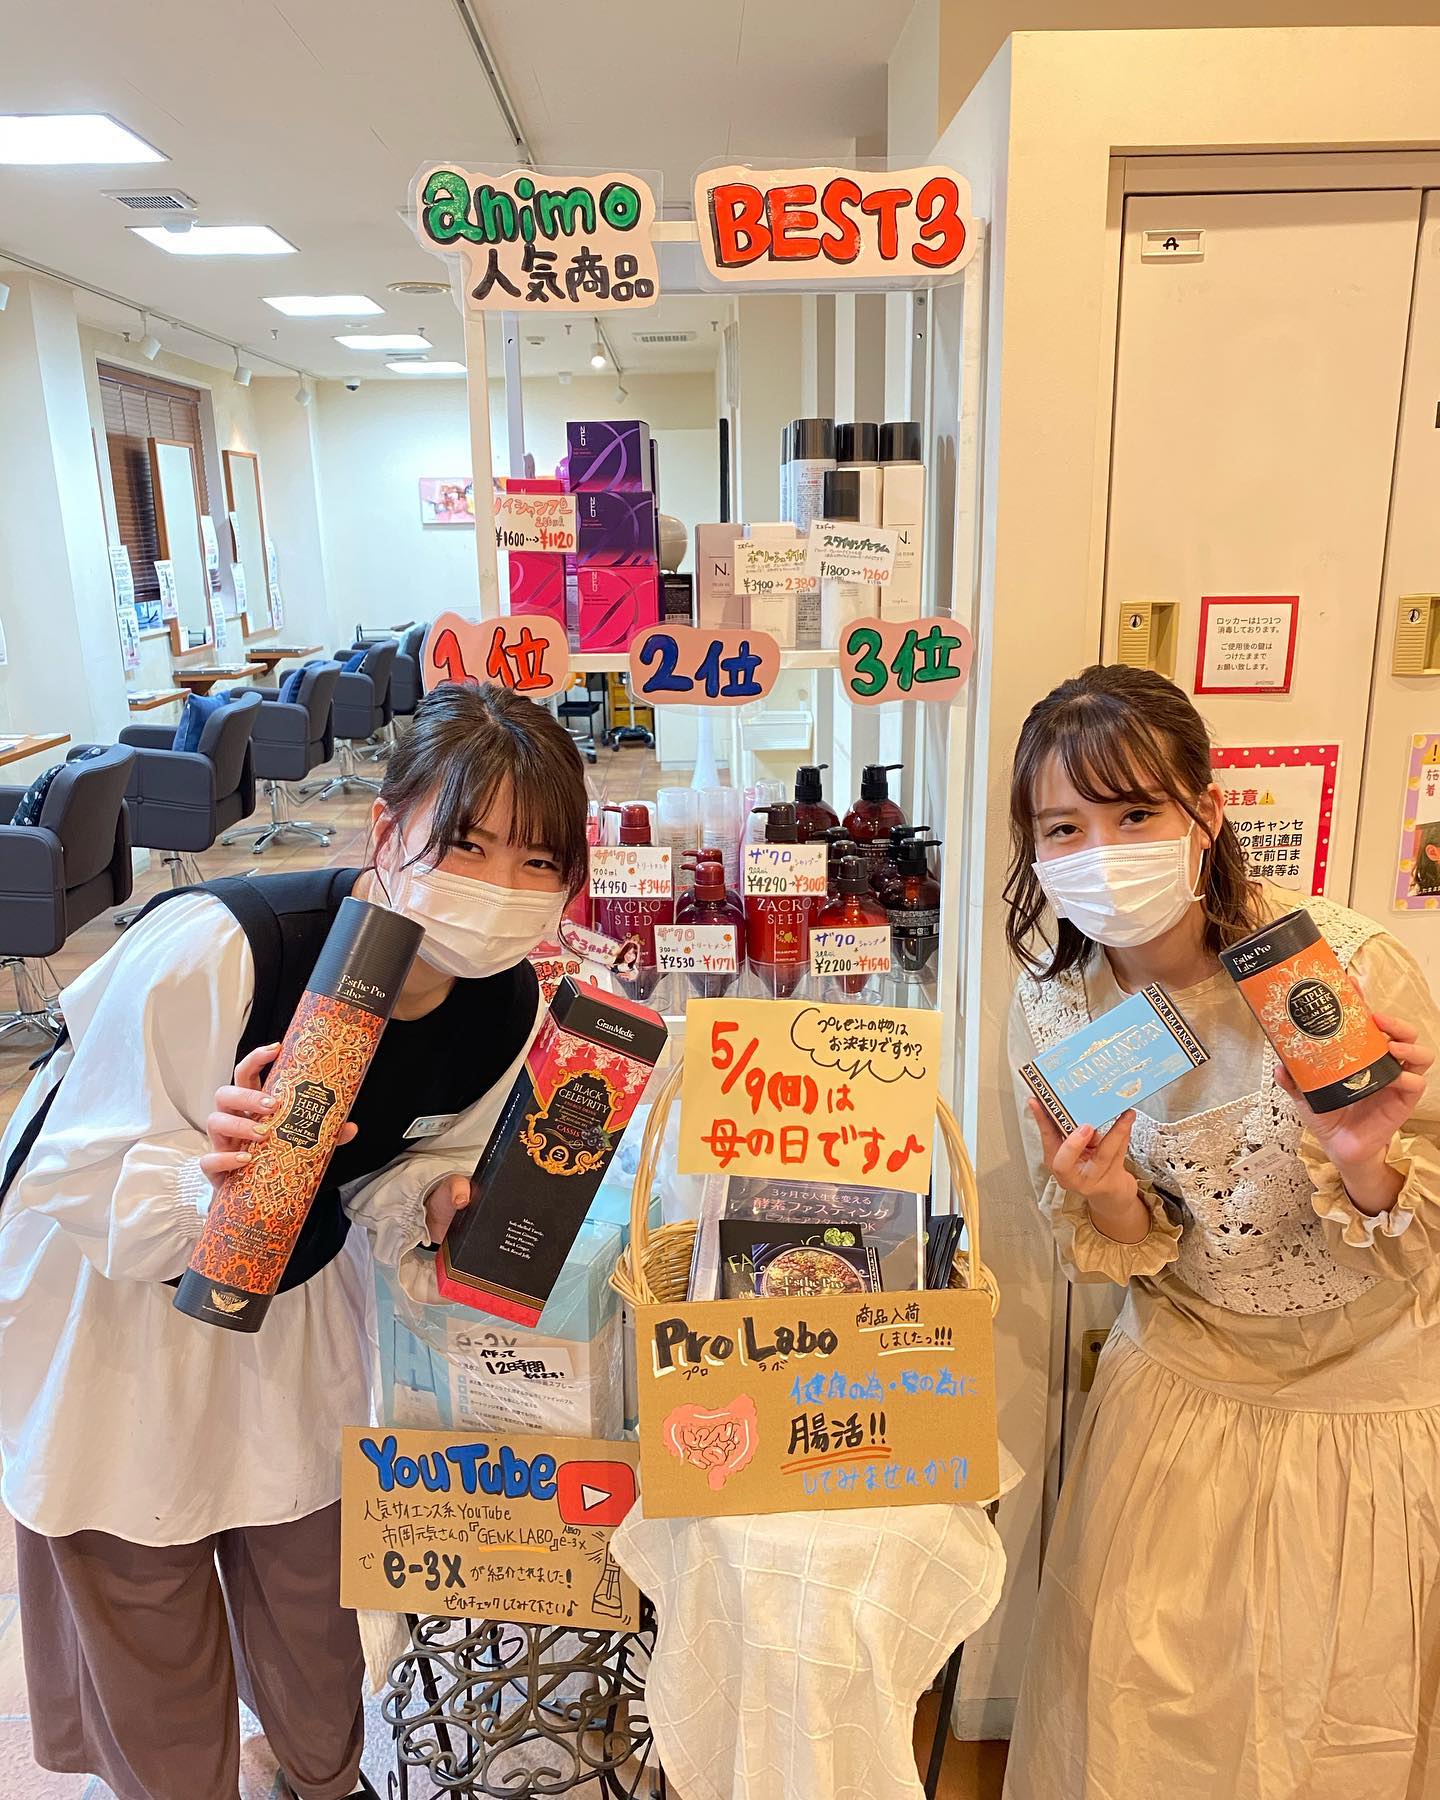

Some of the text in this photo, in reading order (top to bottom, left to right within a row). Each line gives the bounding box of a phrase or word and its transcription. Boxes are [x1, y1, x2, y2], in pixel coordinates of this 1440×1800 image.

[423, 170, 643, 246] animo
[711, 177, 967, 268] BEST3
[1162, 236, 1180, 251] A
[471, 242, 655, 303] 人気商品
[785, 575, 817, 591] 2380
[1217, 626, 1280, 634] 消毒しております。
[1220, 642, 1273, 651] ご使用後の鍵は
[845, 624, 964, 698] 3位
[1224, 652, 1267, 661] つけたままで
[638, 633, 765, 699] 2位
[1223, 788, 1259, 806] 注意
[593, 850, 638, 866] ザクロ
[748, 847, 792, 866] ザクロ
[592, 878, 628, 895] ¥4950
[746, 874, 788, 893] ¥4290
[606, 899, 661, 914] ZACRO
[756, 897, 812, 912] ZACRO
[614, 914, 653, 927] SEED
[766, 912, 805, 926] SEED
[657, 927, 695, 941] ザクロ
[814, 931, 856, 948] ザクロ
[1254, 943, 1272, 957] Pro
[659, 953, 736, 971] ¥2530 ¥1771
[814, 955, 891, 974] ¥2200 ¥1540
[336, 983, 365, 1000] Labo
[340, 973, 386, 999] Esthe Pro
[1292, 986, 1327, 1010] TRIPLE
[1293, 992, 1334, 1019] CUTTER
[1147, 987, 1205, 1065] FLORA BALANCE EX
[572, 1082, 603, 1101] BLACK
[1032, 1076, 1061, 1113] BALANCE
[297, 1097, 326, 1115] HERB
[558, 1088, 610, 1114] CELEVRITY
[292, 1106, 322, 1124] ZYME
[556, 1124, 581, 1138] CASSIS
[753, 1197, 889, 1220] 酵素ファスティング
[783, 1276, 844, 1289] Esthe Pro
[856, 1302, 921, 1326] 商品入荷
[655, 1316, 839, 1369] Pro Labo
[485, 1359, 546, 1375] 12時間
[682, 1359, 789, 1381] プロ ラボ
[787, 1411, 887, 1455] 腸活!!
[358, 1435, 559, 1501] YouTube
